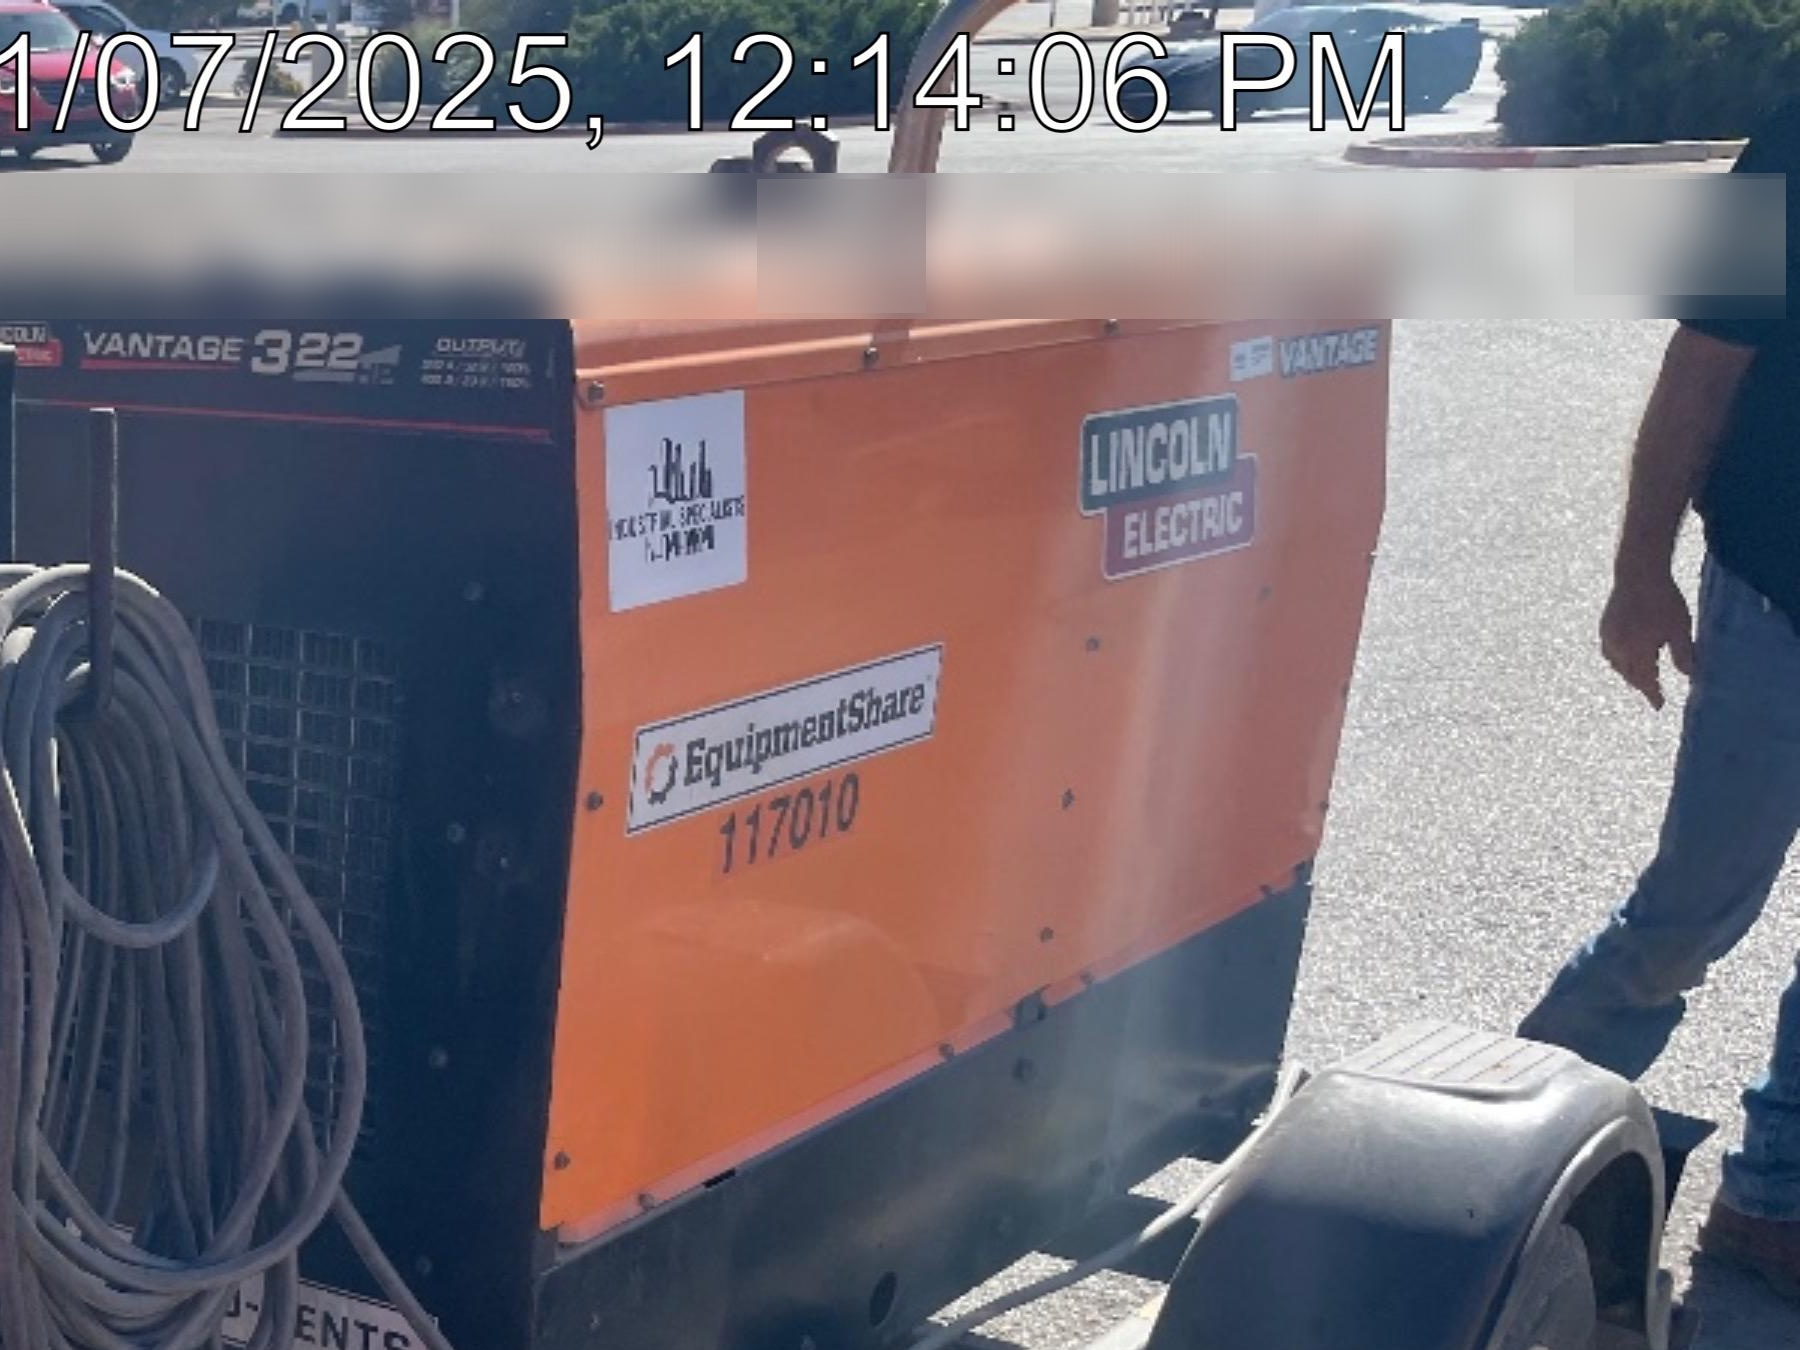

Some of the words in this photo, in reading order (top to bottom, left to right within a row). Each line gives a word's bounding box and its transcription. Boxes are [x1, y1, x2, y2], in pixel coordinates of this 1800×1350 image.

[83, 331, 244, 362] VANTAGE
[250, 329, 365, 375] 322
[1278, 327, 1381, 379] VANTAGE
[1090, 412, 1232, 496] LINCOLN
[1123, 491, 1244, 560] ELECTRIC
[683, 682, 926, 788] EquipmentShare
[718, 773, 860, 874] 117010
